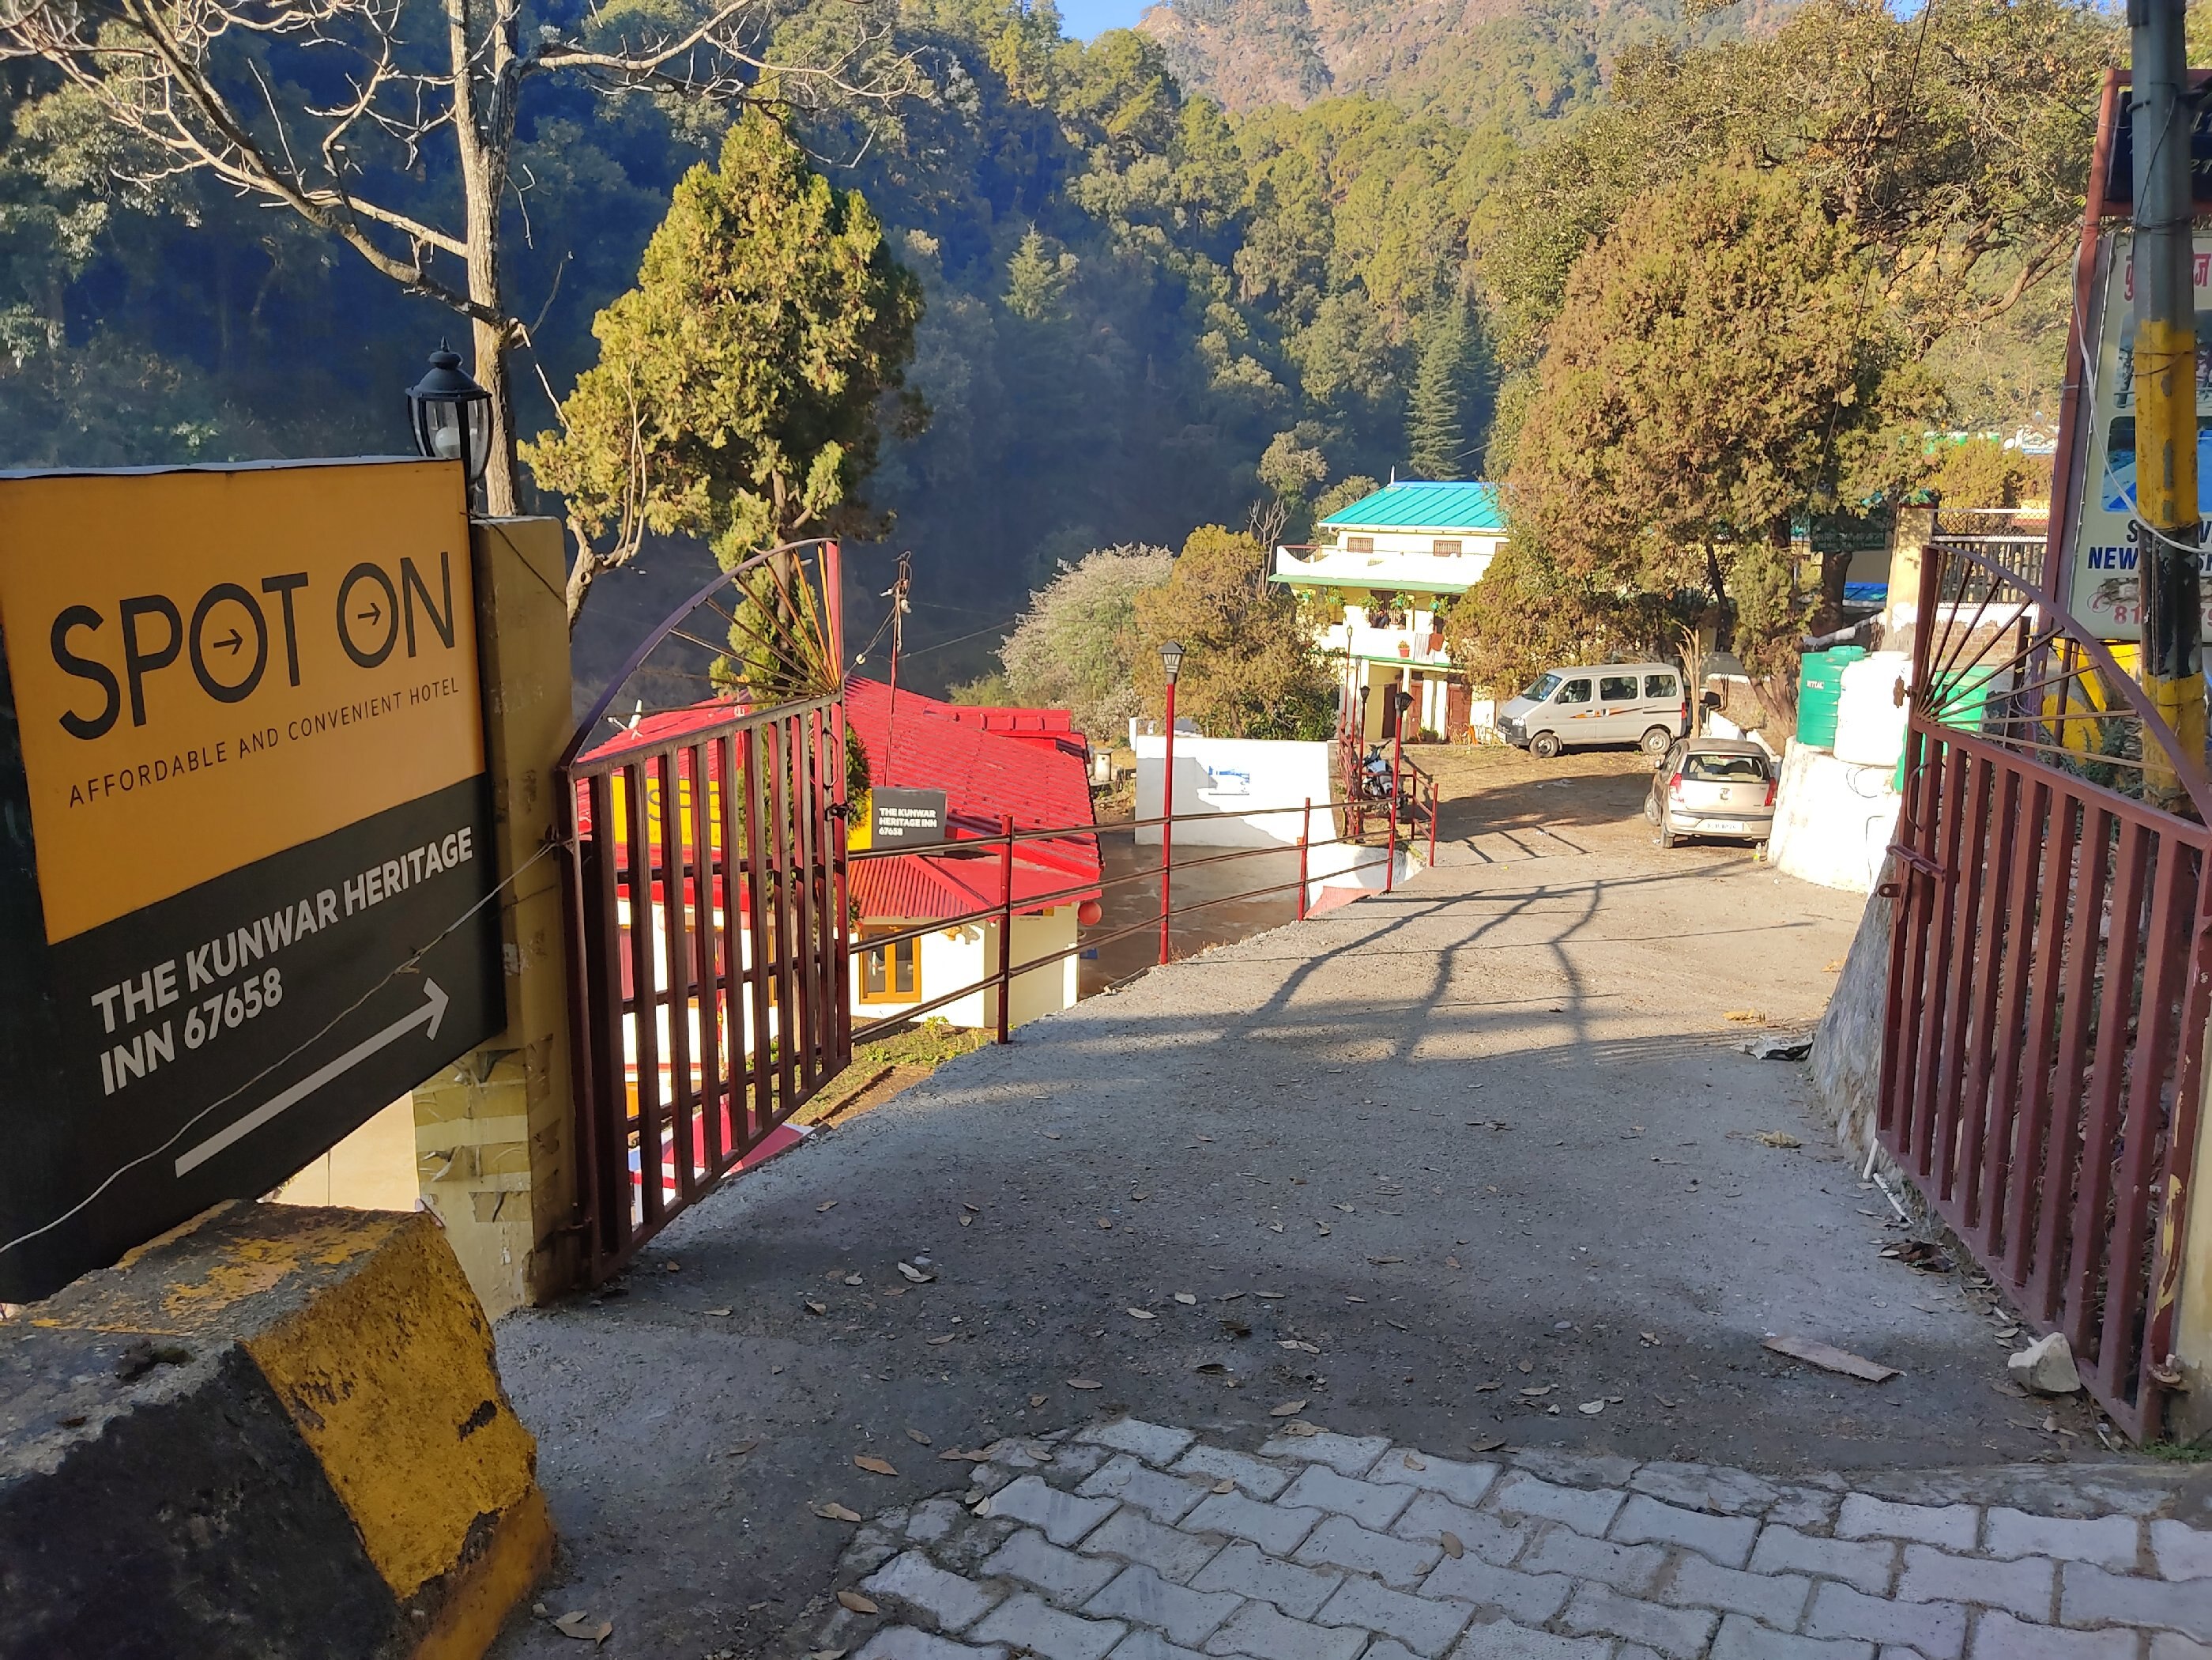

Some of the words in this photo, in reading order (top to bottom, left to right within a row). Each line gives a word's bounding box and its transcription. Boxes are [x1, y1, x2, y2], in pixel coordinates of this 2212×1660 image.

[51, 572, 309, 741] SPOT
[336, 552, 456, 669] ON
[70, 741, 228, 808] AFFORDABLE
[239, 727, 278, 759] AND
[288, 691, 401, 741] CONVENIENT
[410, 677, 459, 705] HOTEL
[878, 807, 898, 817] THE
[898, 808, 936, 818] KUNWAR
[878, 817, 921, 827] HERITAGE
[921, 818, 938, 828] INN
[878, 826, 903, 836] 67658
[91, 959, 179, 1034] THE
[186, 889, 338, 993] KUNWAR
[343, 826, 473, 917] HERITAGE
[100, 1020, 175, 1096] INN
[184, 968, 283, 1050] 67658
